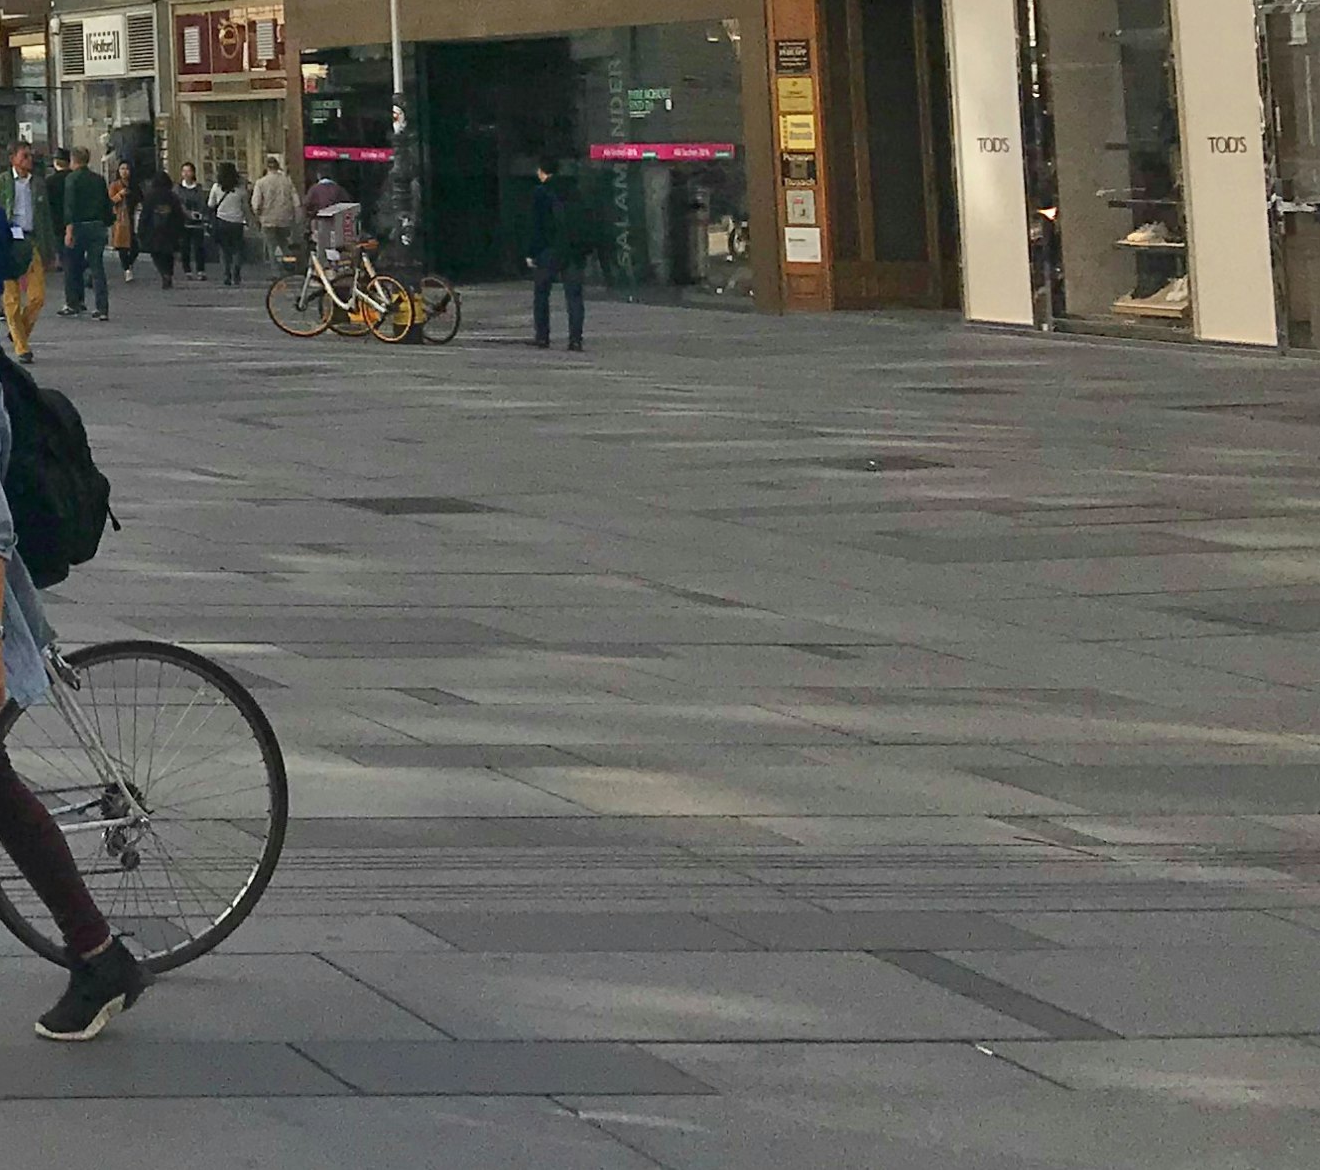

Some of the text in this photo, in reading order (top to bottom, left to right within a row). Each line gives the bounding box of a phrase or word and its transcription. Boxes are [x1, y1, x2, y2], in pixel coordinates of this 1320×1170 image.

[977, 136, 1010, 154] TOD'S
[1207, 135, 1248, 154] TOD'S
[609, 57, 633, 268] SALAMNDER
